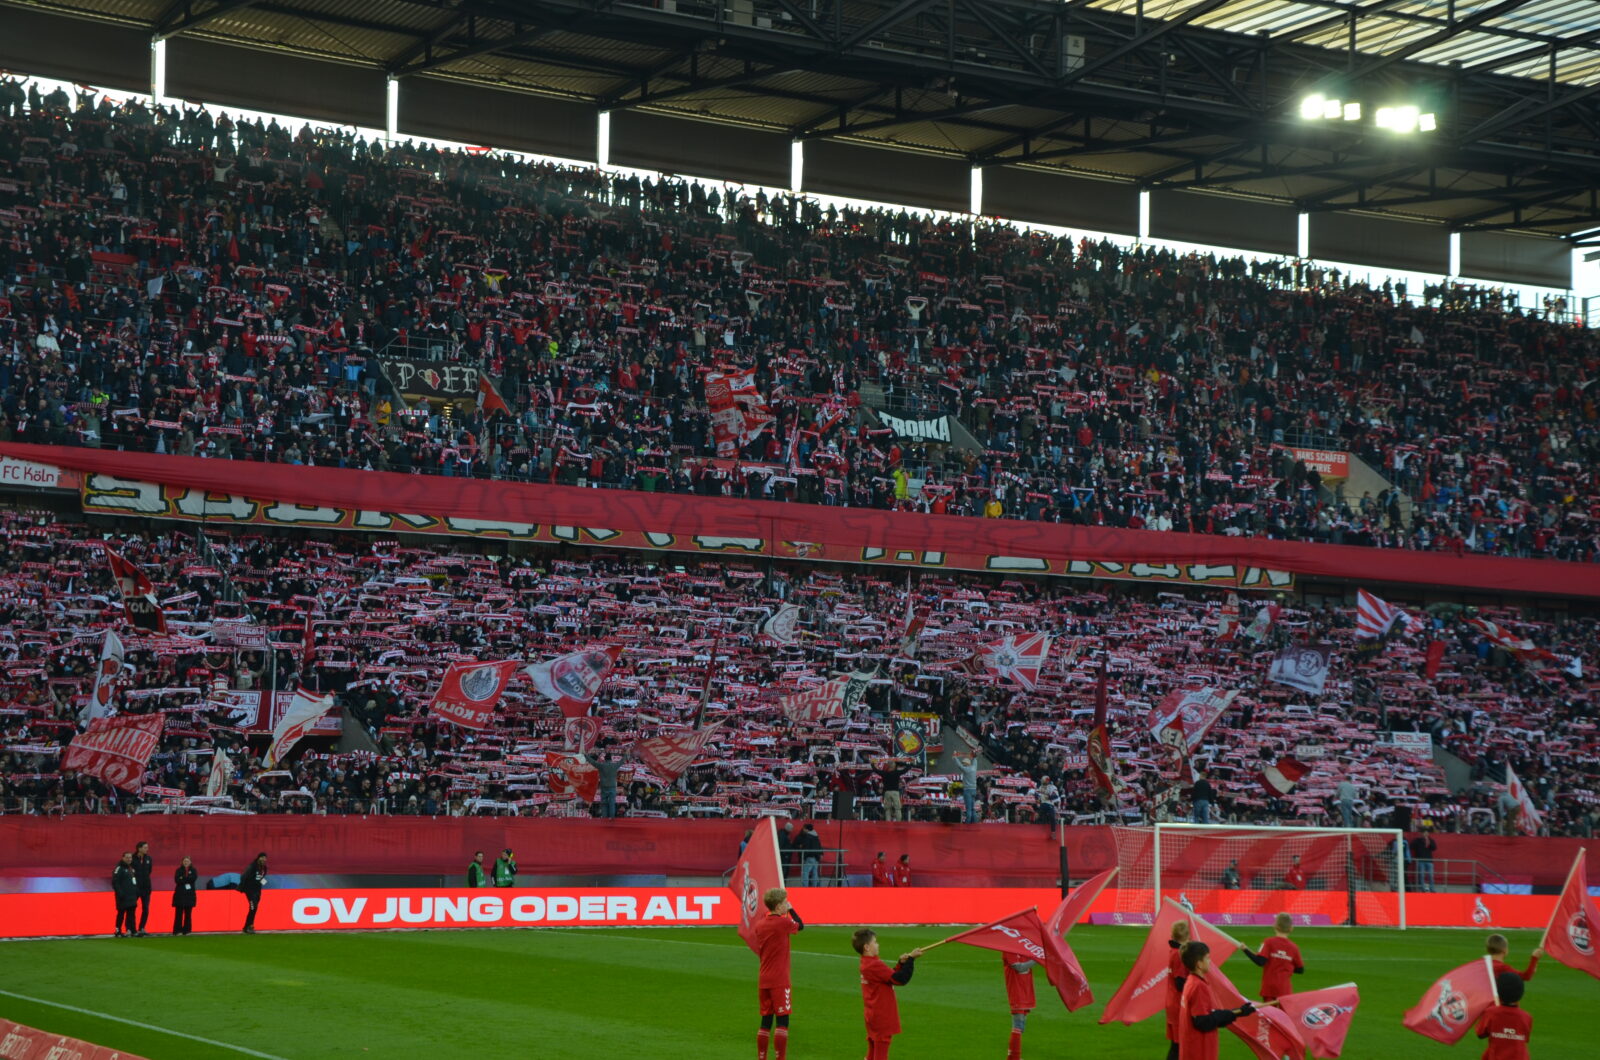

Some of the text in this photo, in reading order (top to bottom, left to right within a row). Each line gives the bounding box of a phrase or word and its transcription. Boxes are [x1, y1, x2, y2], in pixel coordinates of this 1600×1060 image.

[878, 410, 951, 442] TROIKA
[24, 466, 55, 482] Köln
[292, 897, 368, 924] OV
[373, 896, 503, 923] JUNG
[510, 896, 637, 921] ODER
[642, 896, 720, 920] ALT
